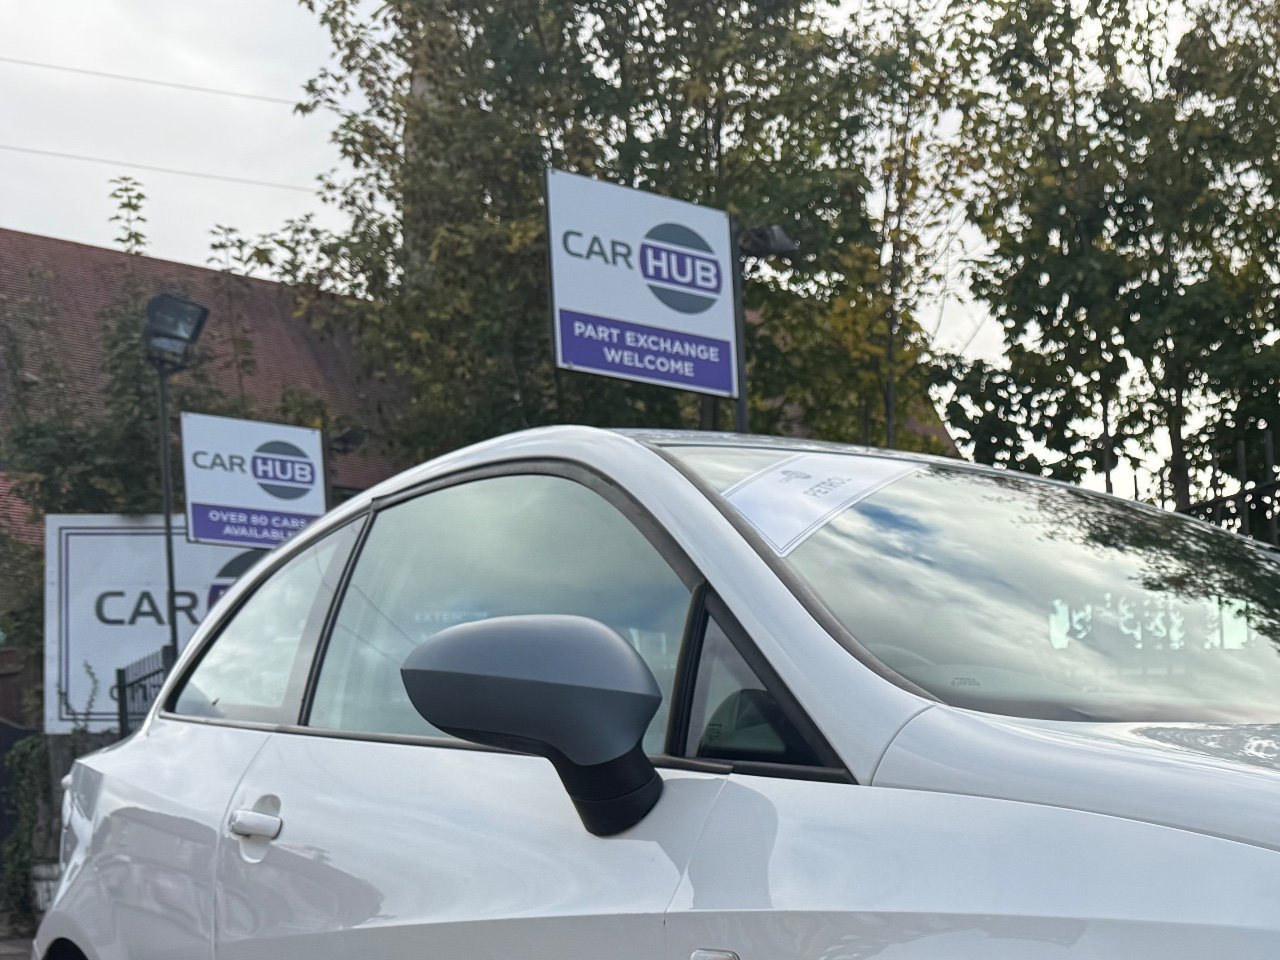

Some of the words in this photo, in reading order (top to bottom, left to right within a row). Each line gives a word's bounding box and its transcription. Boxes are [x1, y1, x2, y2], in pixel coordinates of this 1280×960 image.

[562, 230, 634, 270] CAR
[645, 247, 719, 290] HUB
[573, 320, 621, 344] PART
[625, 331, 720, 363] EXCHANGE
[602, 347, 695, 378] WELCOME
[192, 451, 247, 474] CAR
[256, 457, 313, 483] HUB
[208, 510, 248, 523] OVER
[250, 515, 269, 526] 80
[271, 516, 307, 529] CARS
[95, 591, 200, 626] CAR
